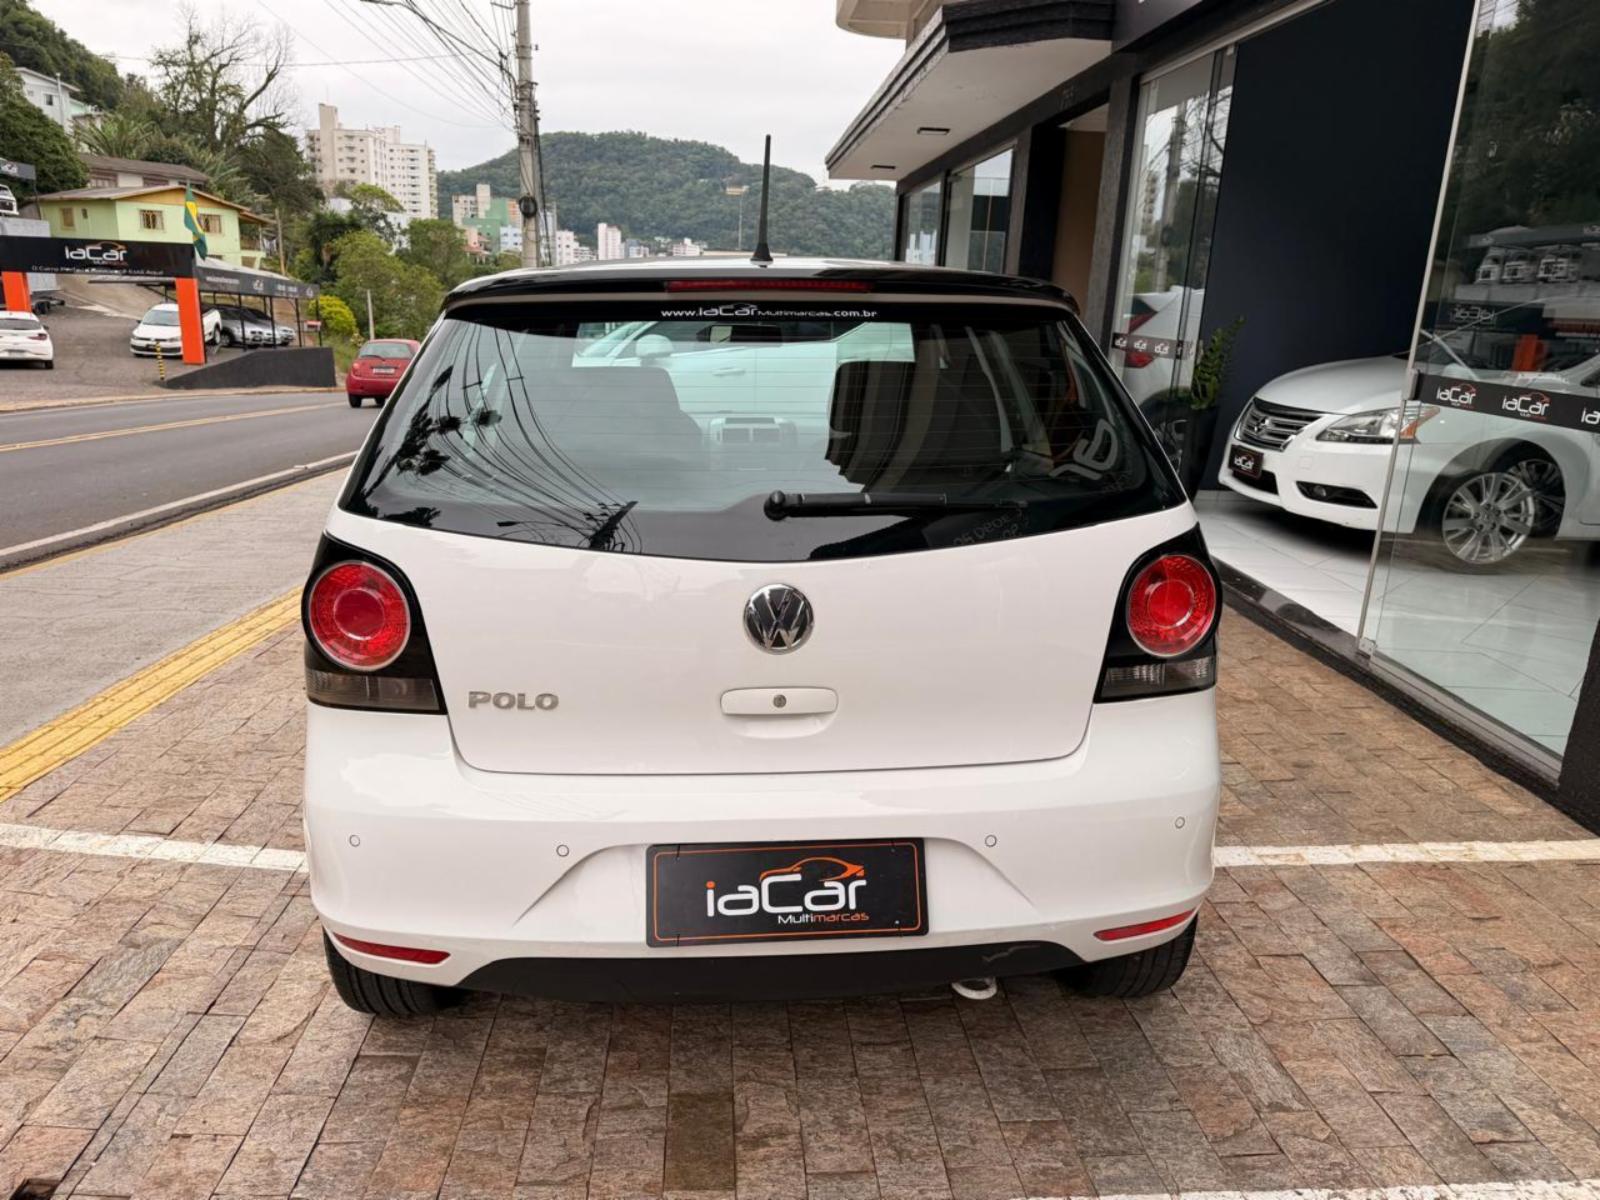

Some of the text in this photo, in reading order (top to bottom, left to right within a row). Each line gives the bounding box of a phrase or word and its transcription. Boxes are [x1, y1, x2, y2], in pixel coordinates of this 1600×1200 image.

[468, 691, 559, 711] POLO
[706, 873, 867, 917] iaCar
[777, 912, 870, 925] Multimarcas
